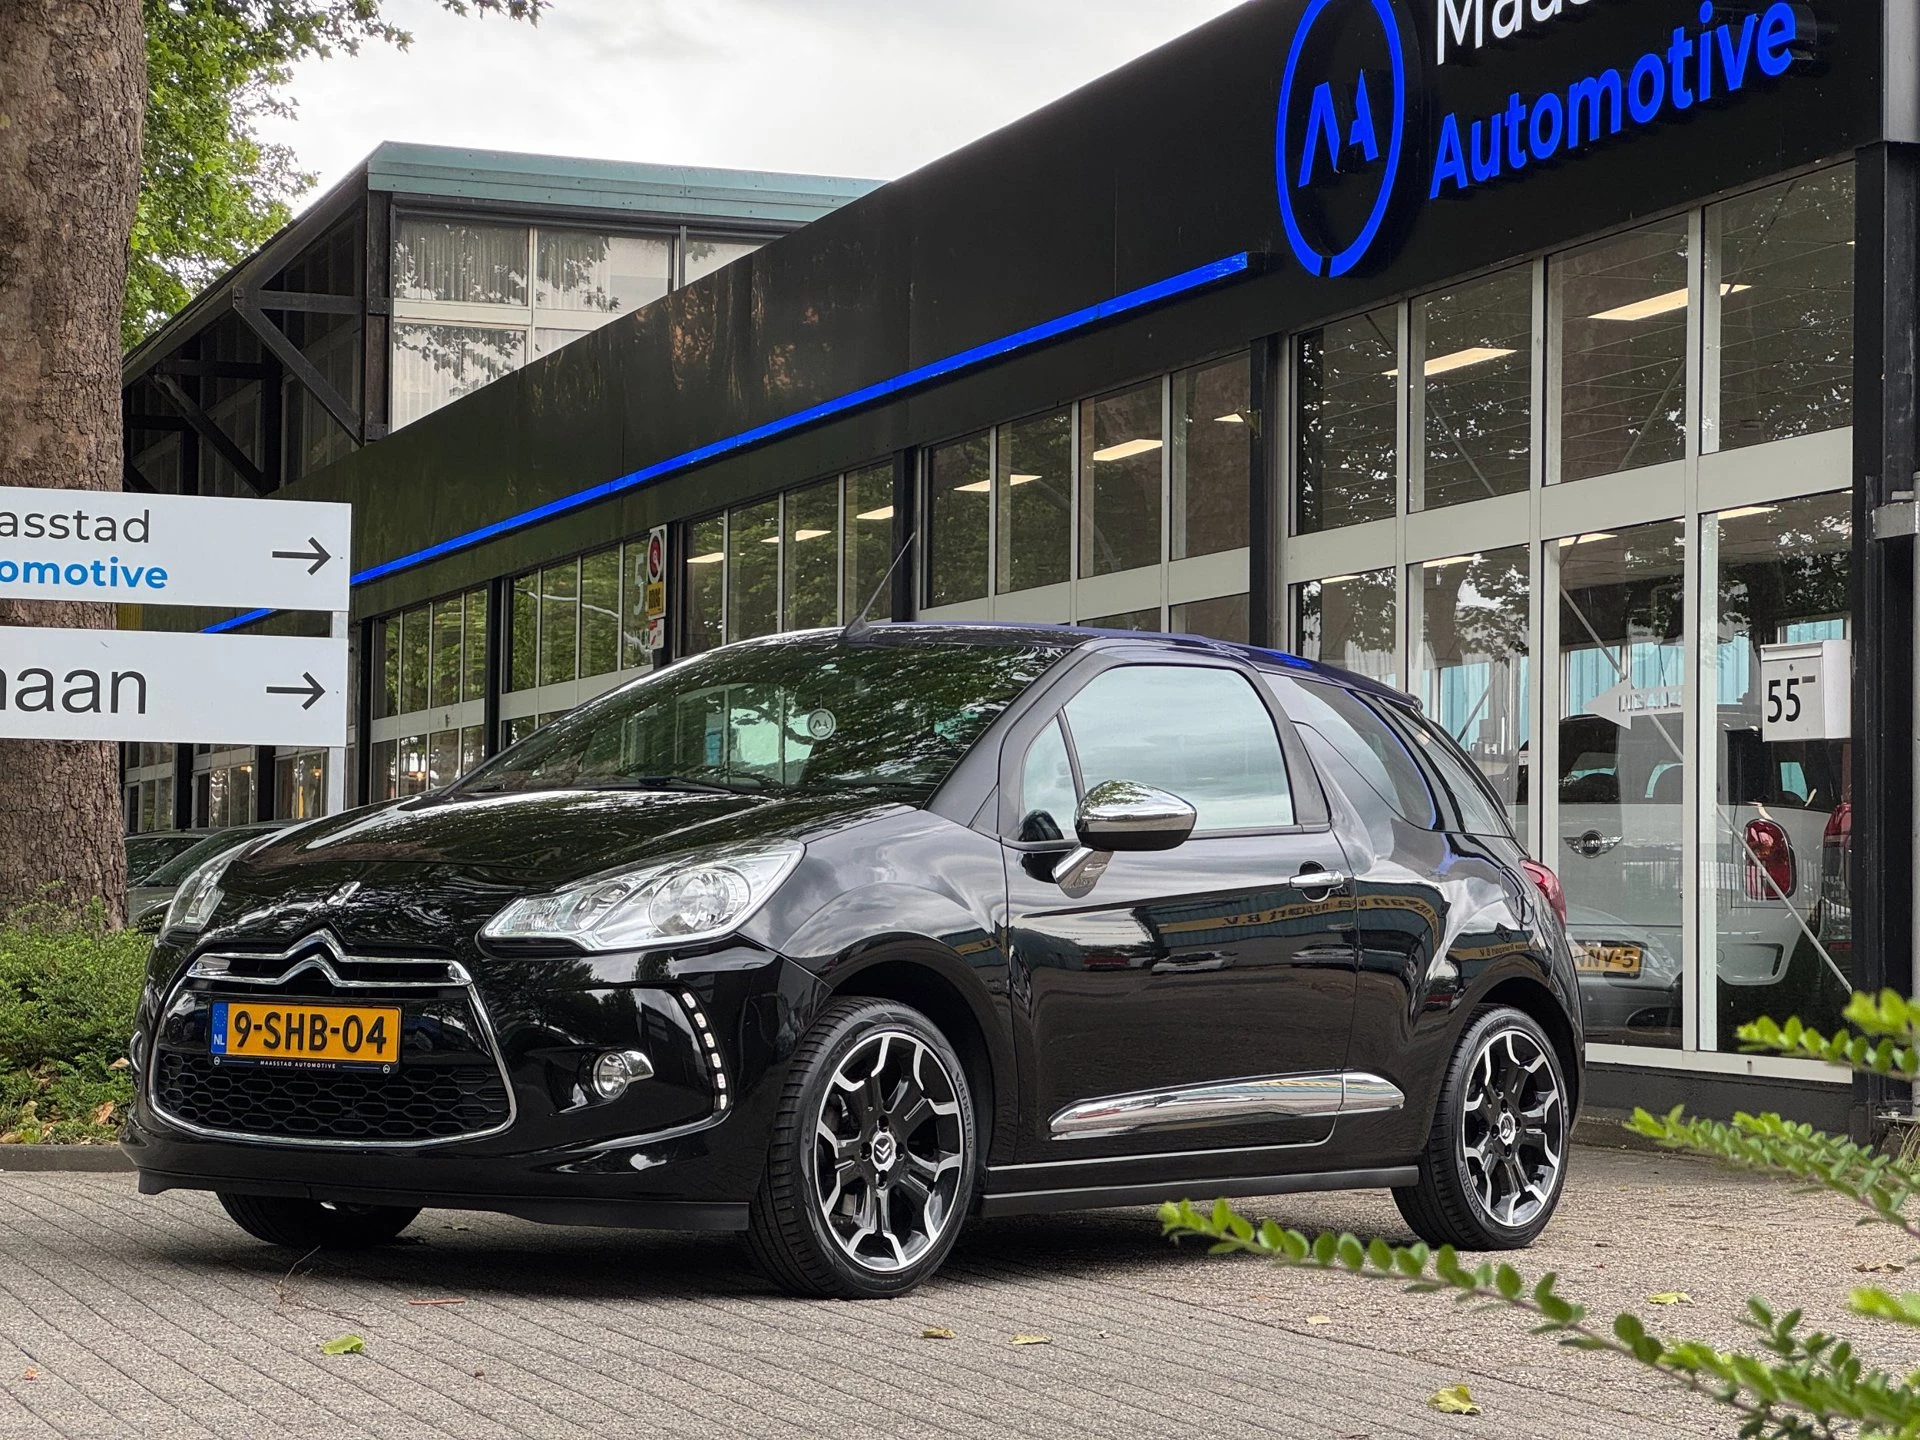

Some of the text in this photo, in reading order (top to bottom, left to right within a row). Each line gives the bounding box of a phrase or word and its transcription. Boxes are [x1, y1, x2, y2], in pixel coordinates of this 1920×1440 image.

[1429, 1, 1796, 199] Automotive
[0, 509, 150, 543] asstad
[0, 556, 168, 589] omotive
[1767, 678, 1801, 723] 55
[213, 1033, 226, 1046] NL
[233, 1010, 388, 1054] 9-SHB-04
[955, 1071, 974, 1149] VREDESTEIN
